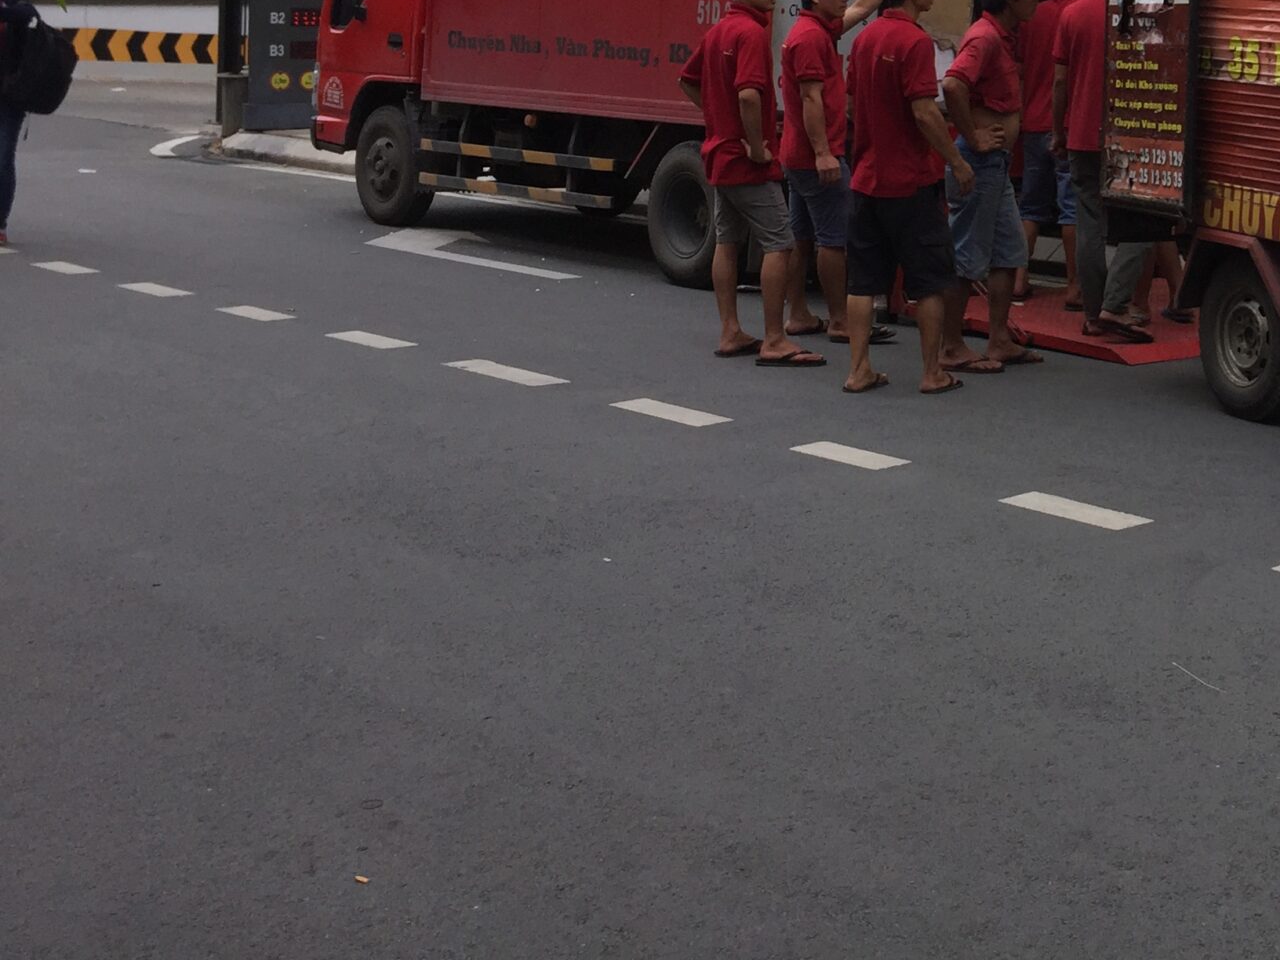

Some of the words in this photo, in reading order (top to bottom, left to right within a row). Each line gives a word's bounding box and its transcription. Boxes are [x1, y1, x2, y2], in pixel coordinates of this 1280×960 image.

[269, 12, 286, 25] B2
[269, 45, 285, 57] B3
[1227, 35, 1261, 83] 35
